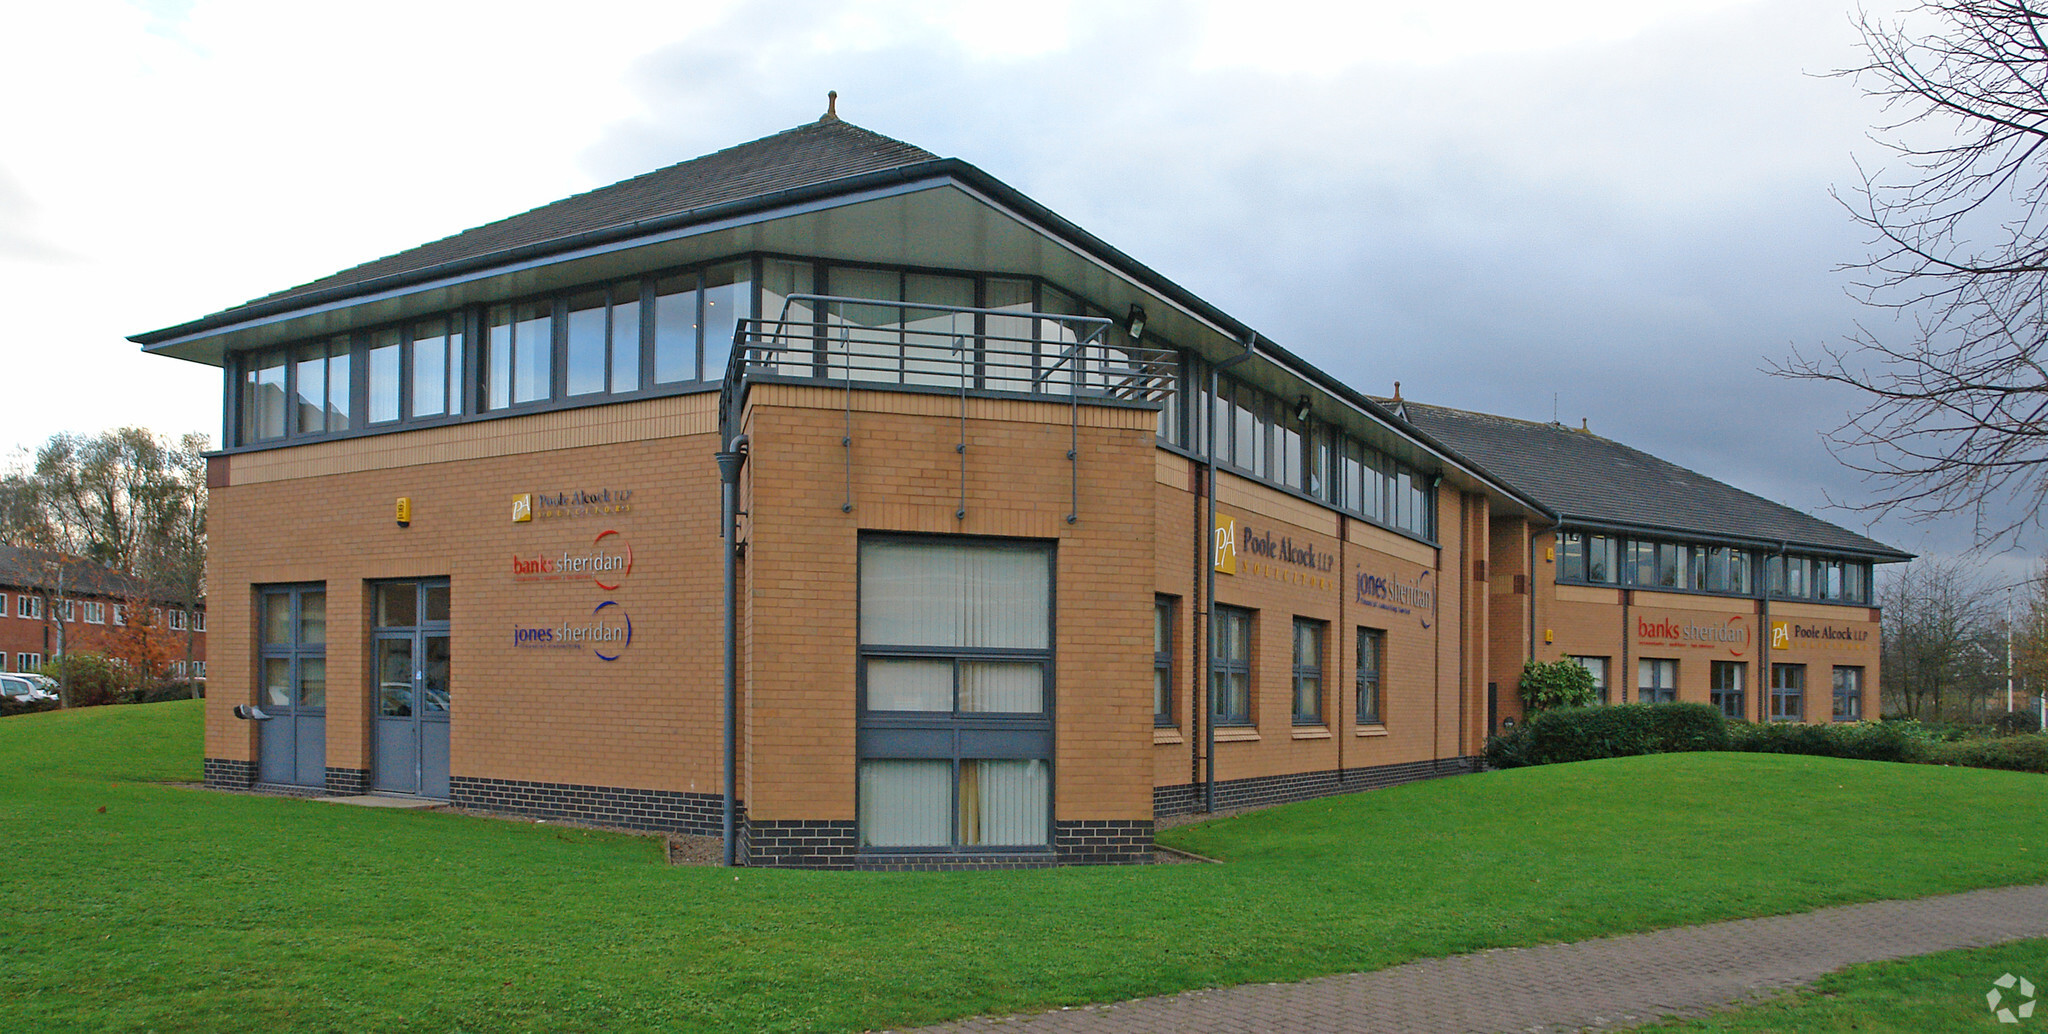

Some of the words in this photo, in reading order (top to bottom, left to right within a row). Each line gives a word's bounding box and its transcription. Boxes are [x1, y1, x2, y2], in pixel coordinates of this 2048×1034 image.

[537, 504, 631, 518] SOLICITORS
[539, 491, 569, 508] Poole
[571, 487, 610, 505] Alcock
[614, 489, 632, 501] LLP
[1243, 526, 1277, 559] Poole
[1279, 535, 1316, 568] Alcock
[1318, 551, 1334, 572] LLP
[513, 554, 553, 575] banks
[556, 551, 623, 573] sheridan
[1242, 559, 1334, 591] SOLICITORS
[1355, 563, 1387, 602] jones
[1388, 572, 1431, 609] sheridan
[513, 623, 553, 647] jones
[556, 620, 623, 642] sheridan
[1638, 616, 1680, 640] banks
[1683, 619, 1744, 643] sheridan
[1794, 624, 1820, 639] Poole
[1822, 625, 1852, 641] Alcock
[1854, 629, 1868, 641] LLP
